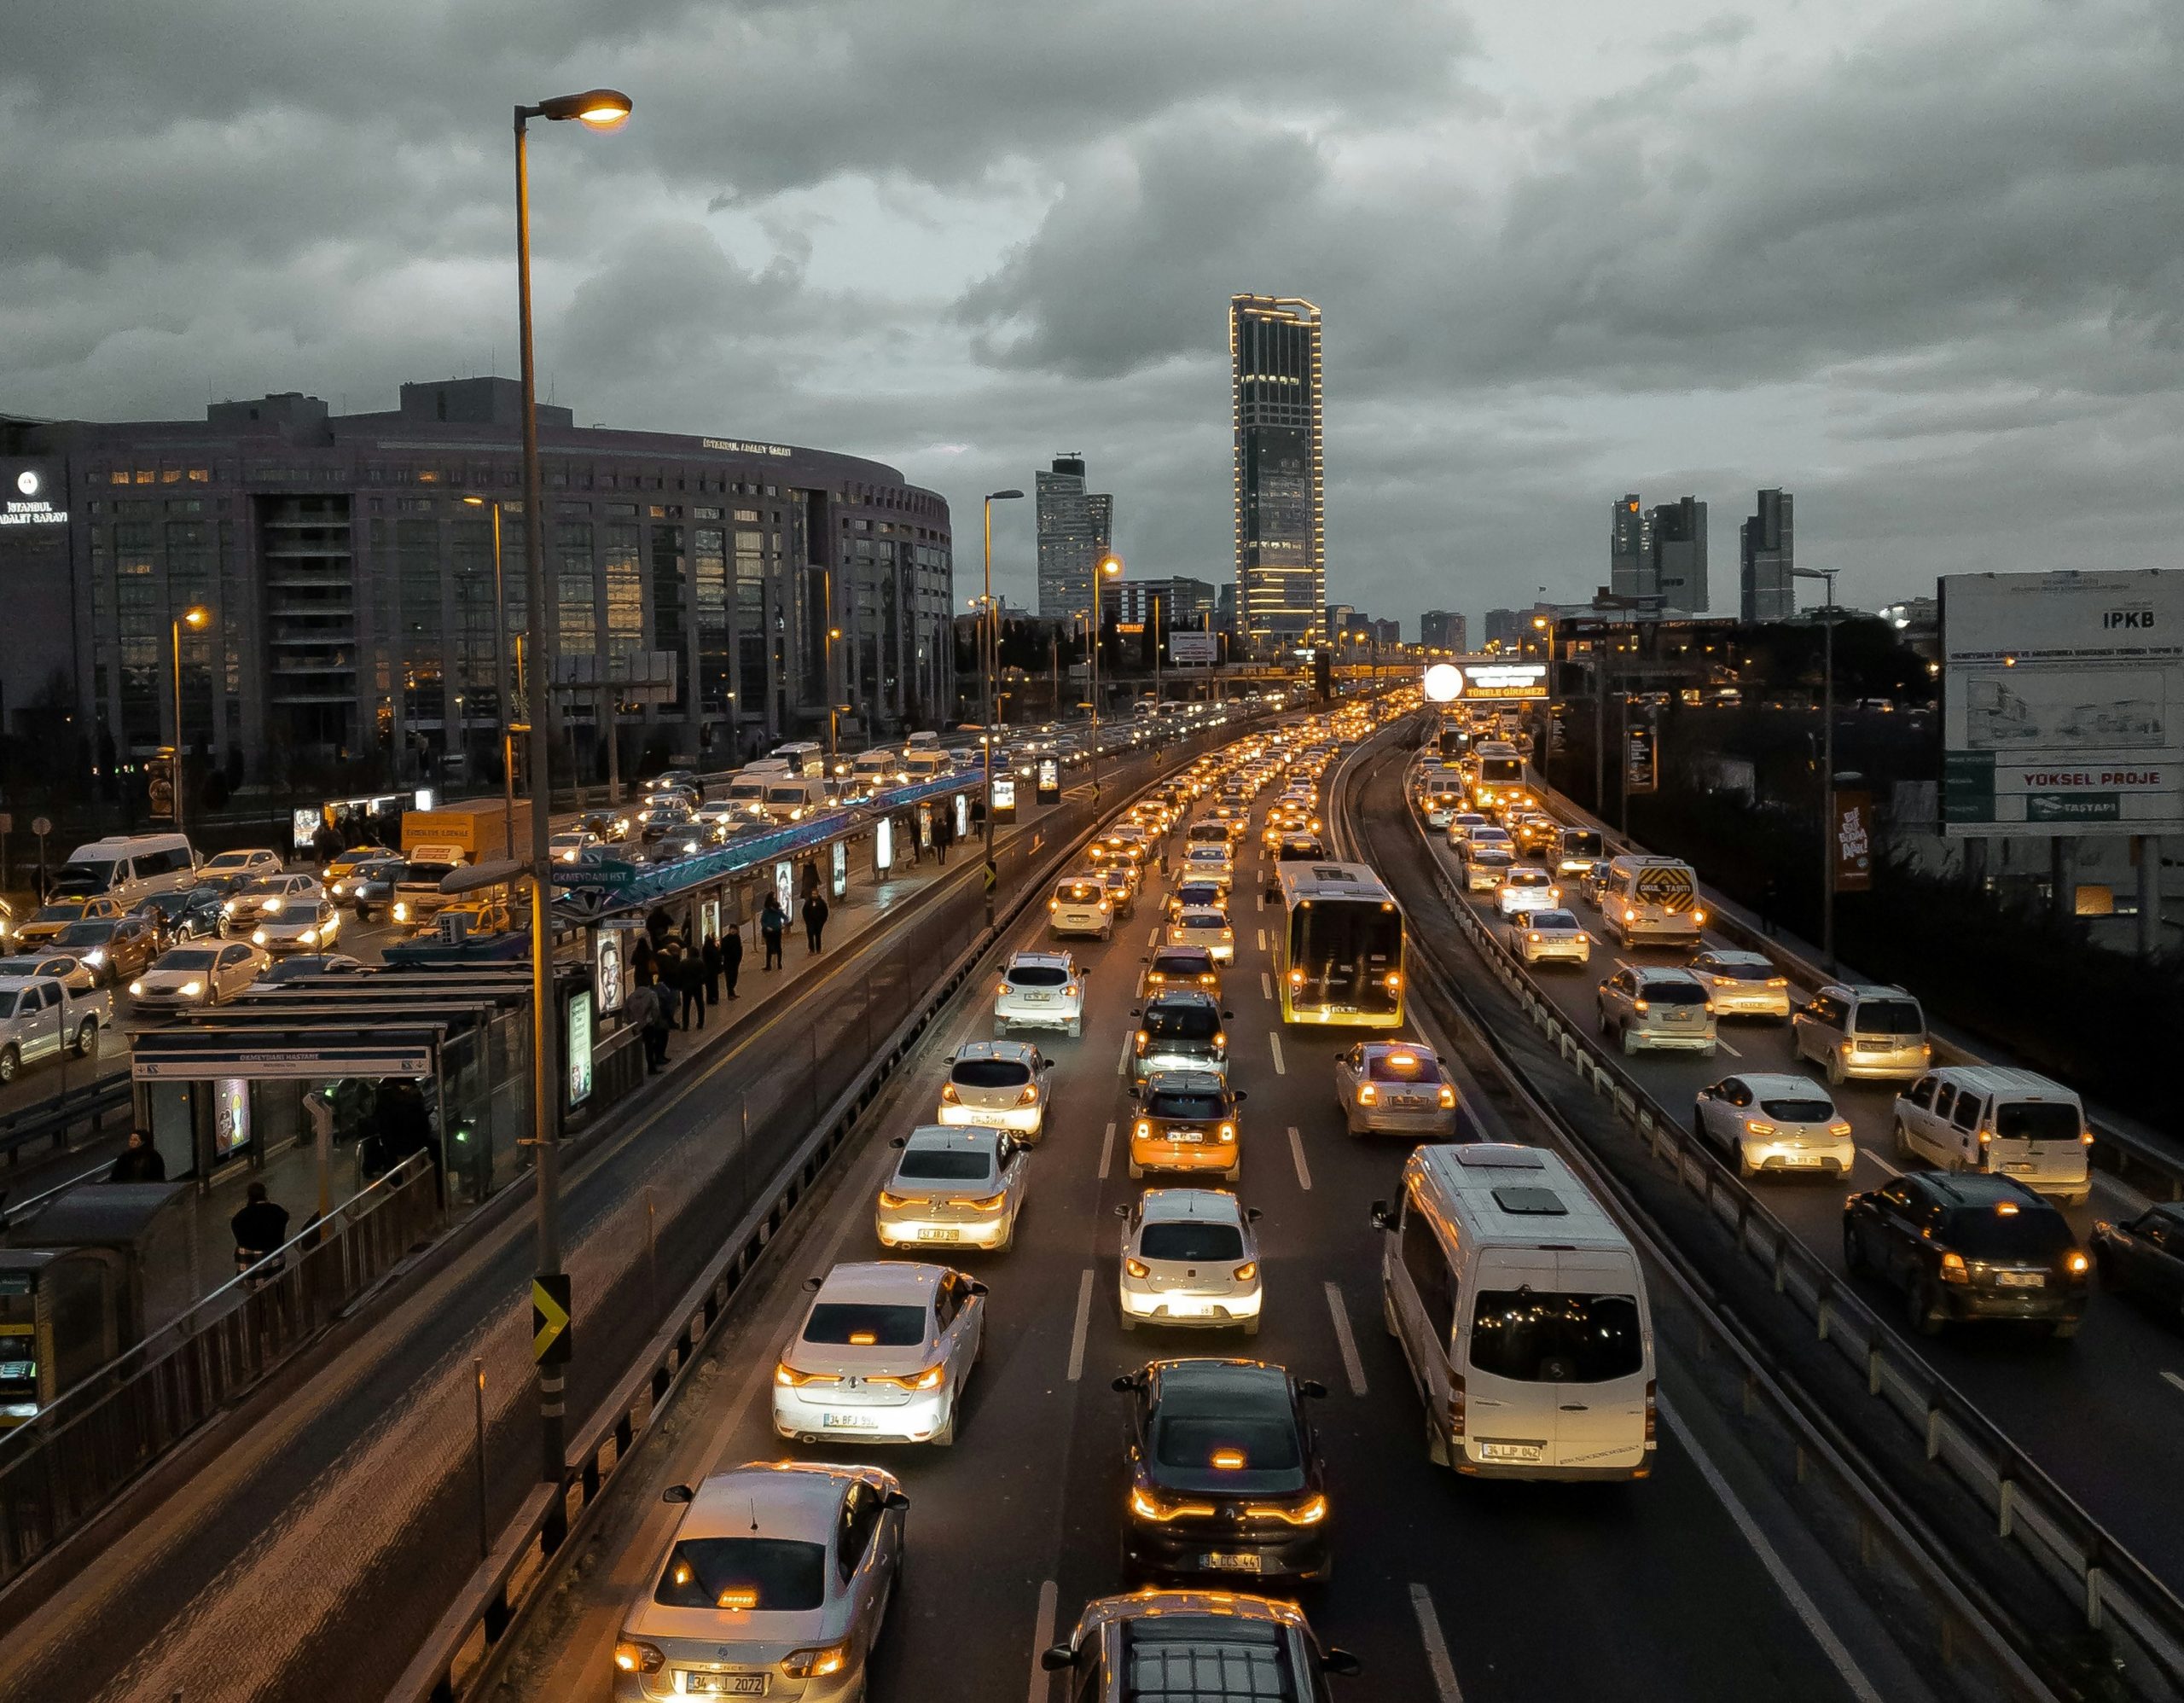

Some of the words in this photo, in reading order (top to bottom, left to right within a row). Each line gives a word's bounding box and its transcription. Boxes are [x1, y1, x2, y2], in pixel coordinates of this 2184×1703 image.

[7, 501, 53, 513] İSTANBUL
[32, 512, 68, 523] SARAYI
[2103, 611, 2155, 629] IPKB
[2101, 772, 2161, 784] PROJE
[553, 872, 608, 882] OKMEYDANI
[830, 1415, 839, 1424] 34
[1488, 1445, 1498, 1455] 34
[694, 1677, 706, 1689] 34
[735, 1677, 762, 1691] 2072
